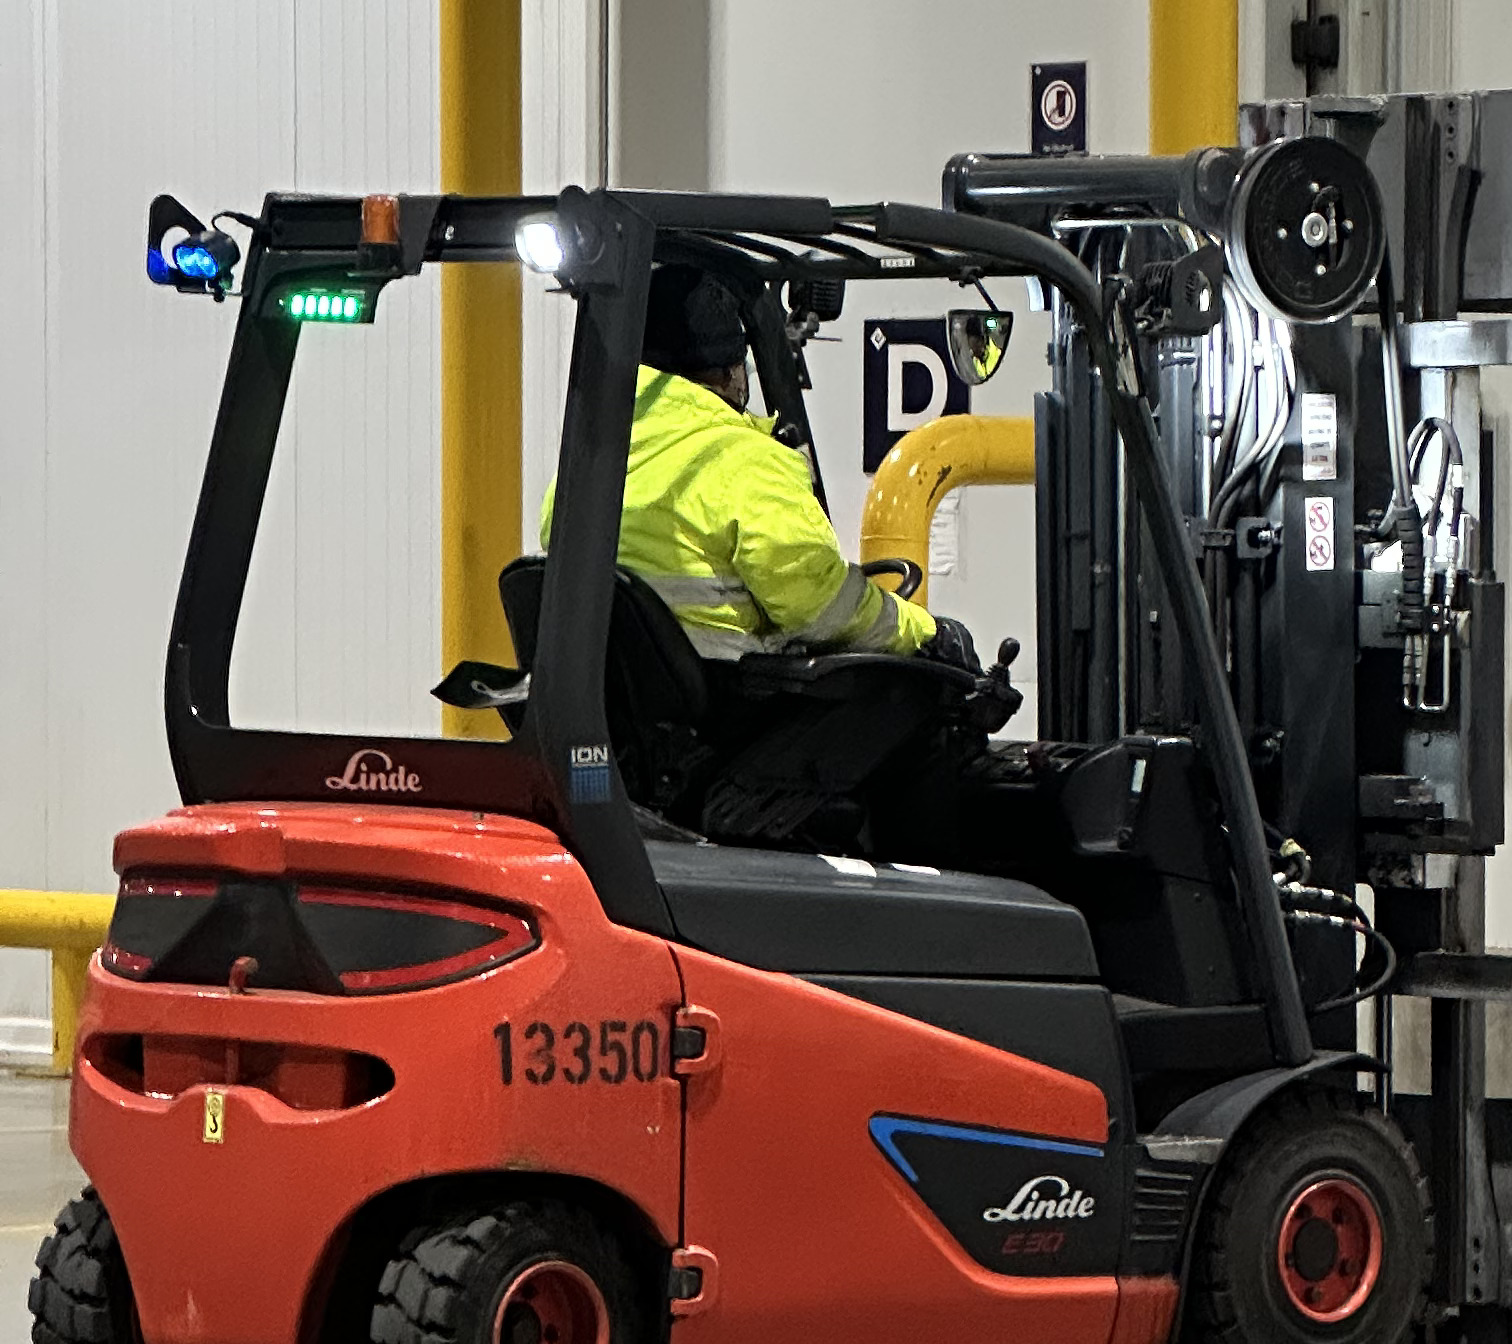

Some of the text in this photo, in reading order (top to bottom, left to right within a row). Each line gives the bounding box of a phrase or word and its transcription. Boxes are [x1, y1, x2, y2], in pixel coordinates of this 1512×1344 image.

[888, 344, 949, 432] D
[325, 748, 423, 794] Linde
[571, 745, 609, 764] ION
[492, 1019, 660, 1085] 13350
[983, 1175, 1095, 1222] Linde
